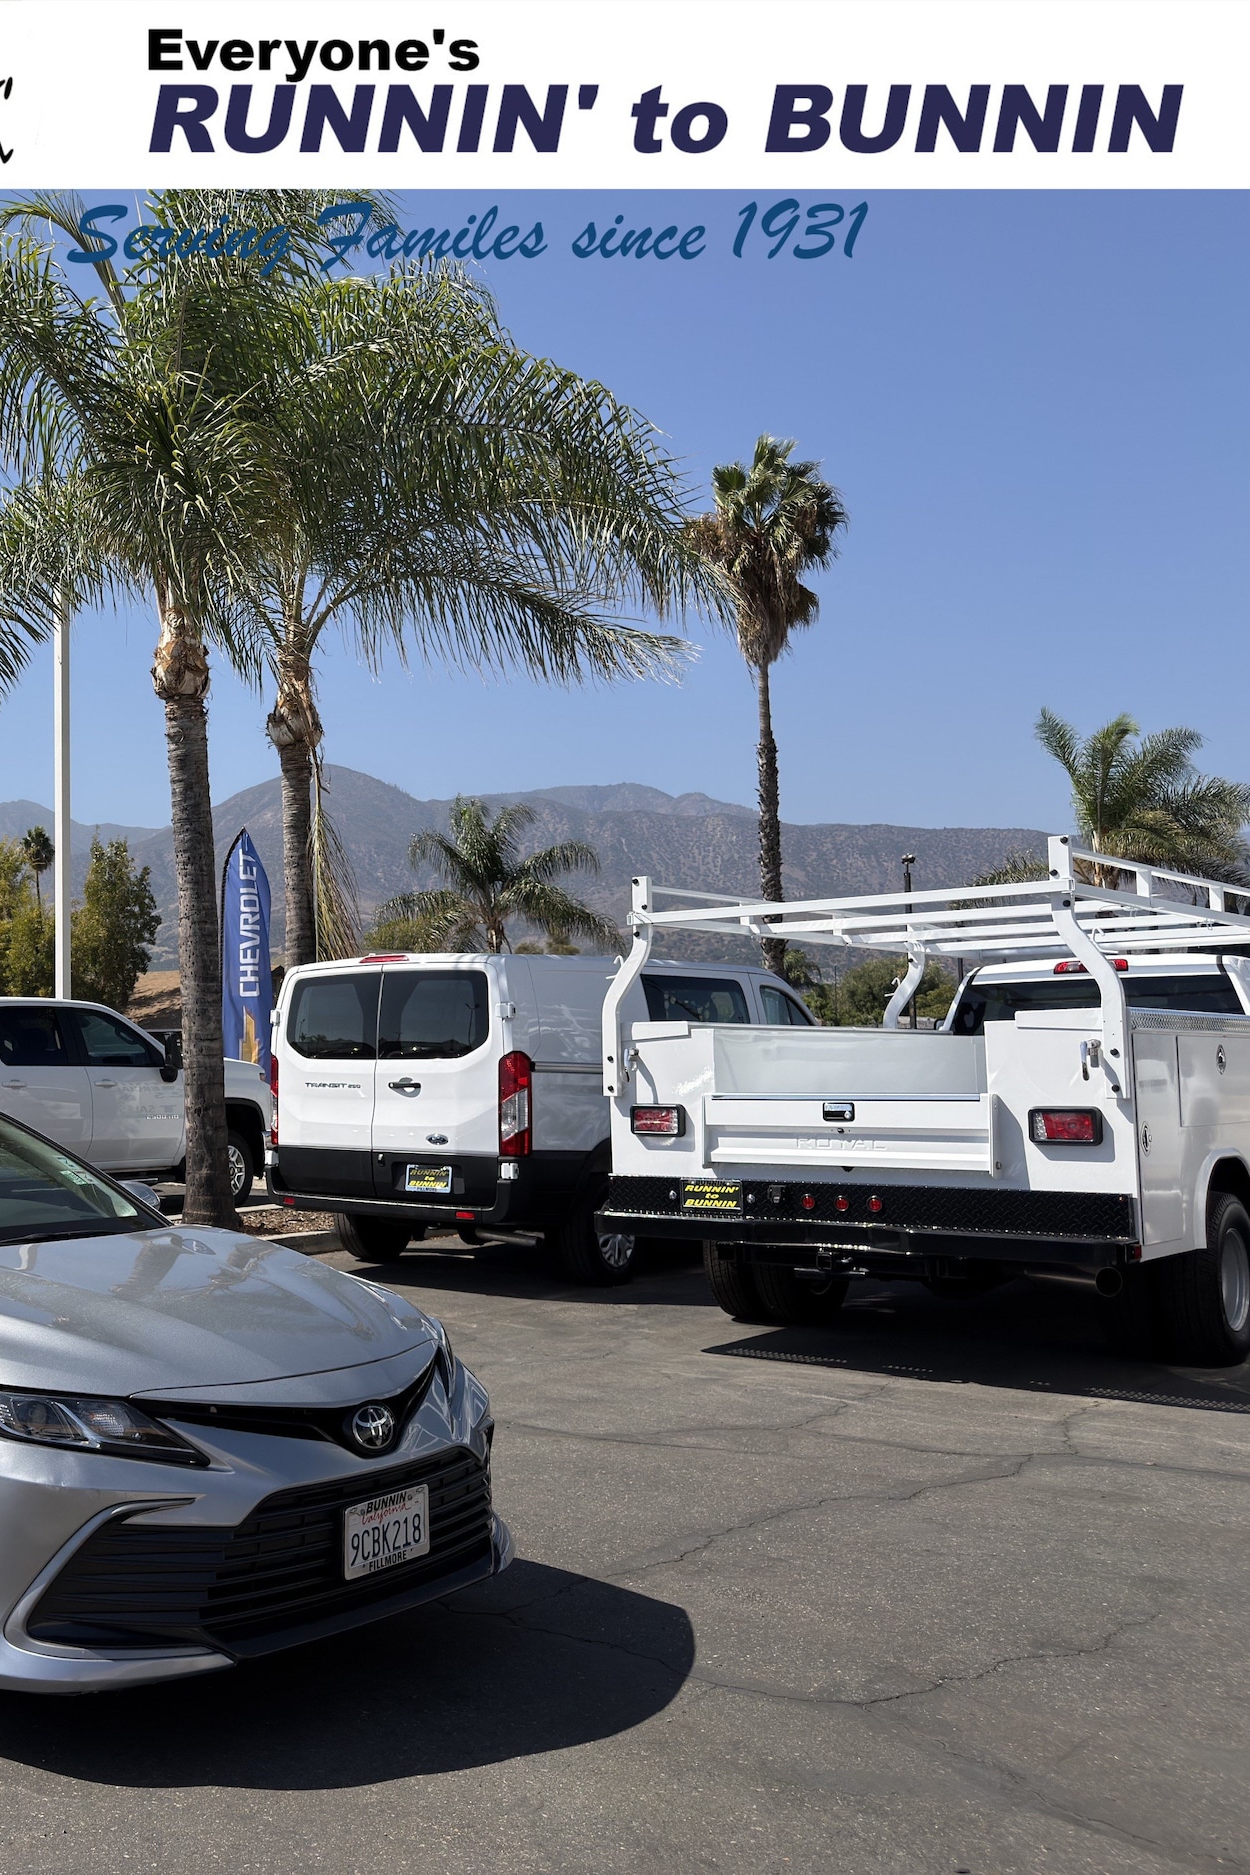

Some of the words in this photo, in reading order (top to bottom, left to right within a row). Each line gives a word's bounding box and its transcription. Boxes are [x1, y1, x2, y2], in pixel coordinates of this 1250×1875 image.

[238, 848, 261, 998] CHEVROLET
[796, 1138, 887, 1150] ROYAL
[684, 1185, 740, 1193] RUNNIN'
[685, 1199, 738, 1207] BUNNIN
[366, 1491, 407, 1514] BUNNIN
[351, 1513, 422, 1568] 9CBK218
[369, 1550, 407, 1572] FILLMORE
